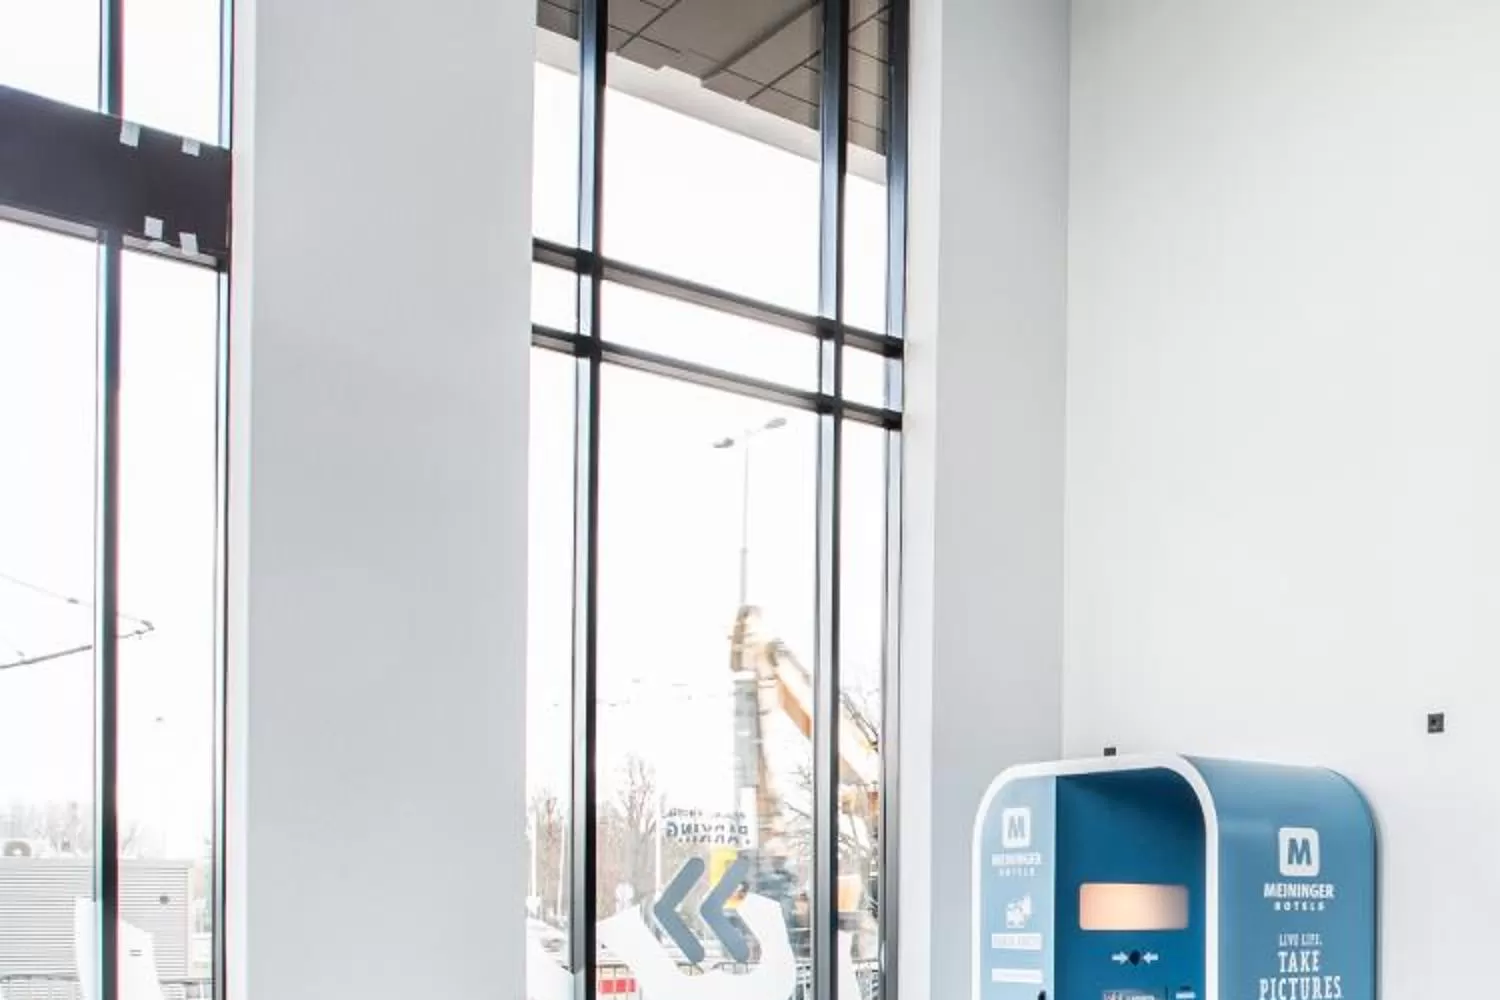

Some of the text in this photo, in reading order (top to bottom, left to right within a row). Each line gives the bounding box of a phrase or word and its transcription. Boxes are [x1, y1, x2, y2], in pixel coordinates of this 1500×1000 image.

[1287, 837, 1313, 866] M
[1263, 882, 1336, 899] MEININGER
[1273, 901, 1326, 911] HOTELS
[1279, 933, 1300, 947] LIVE
[1277, 949, 1321, 973] TAKE
